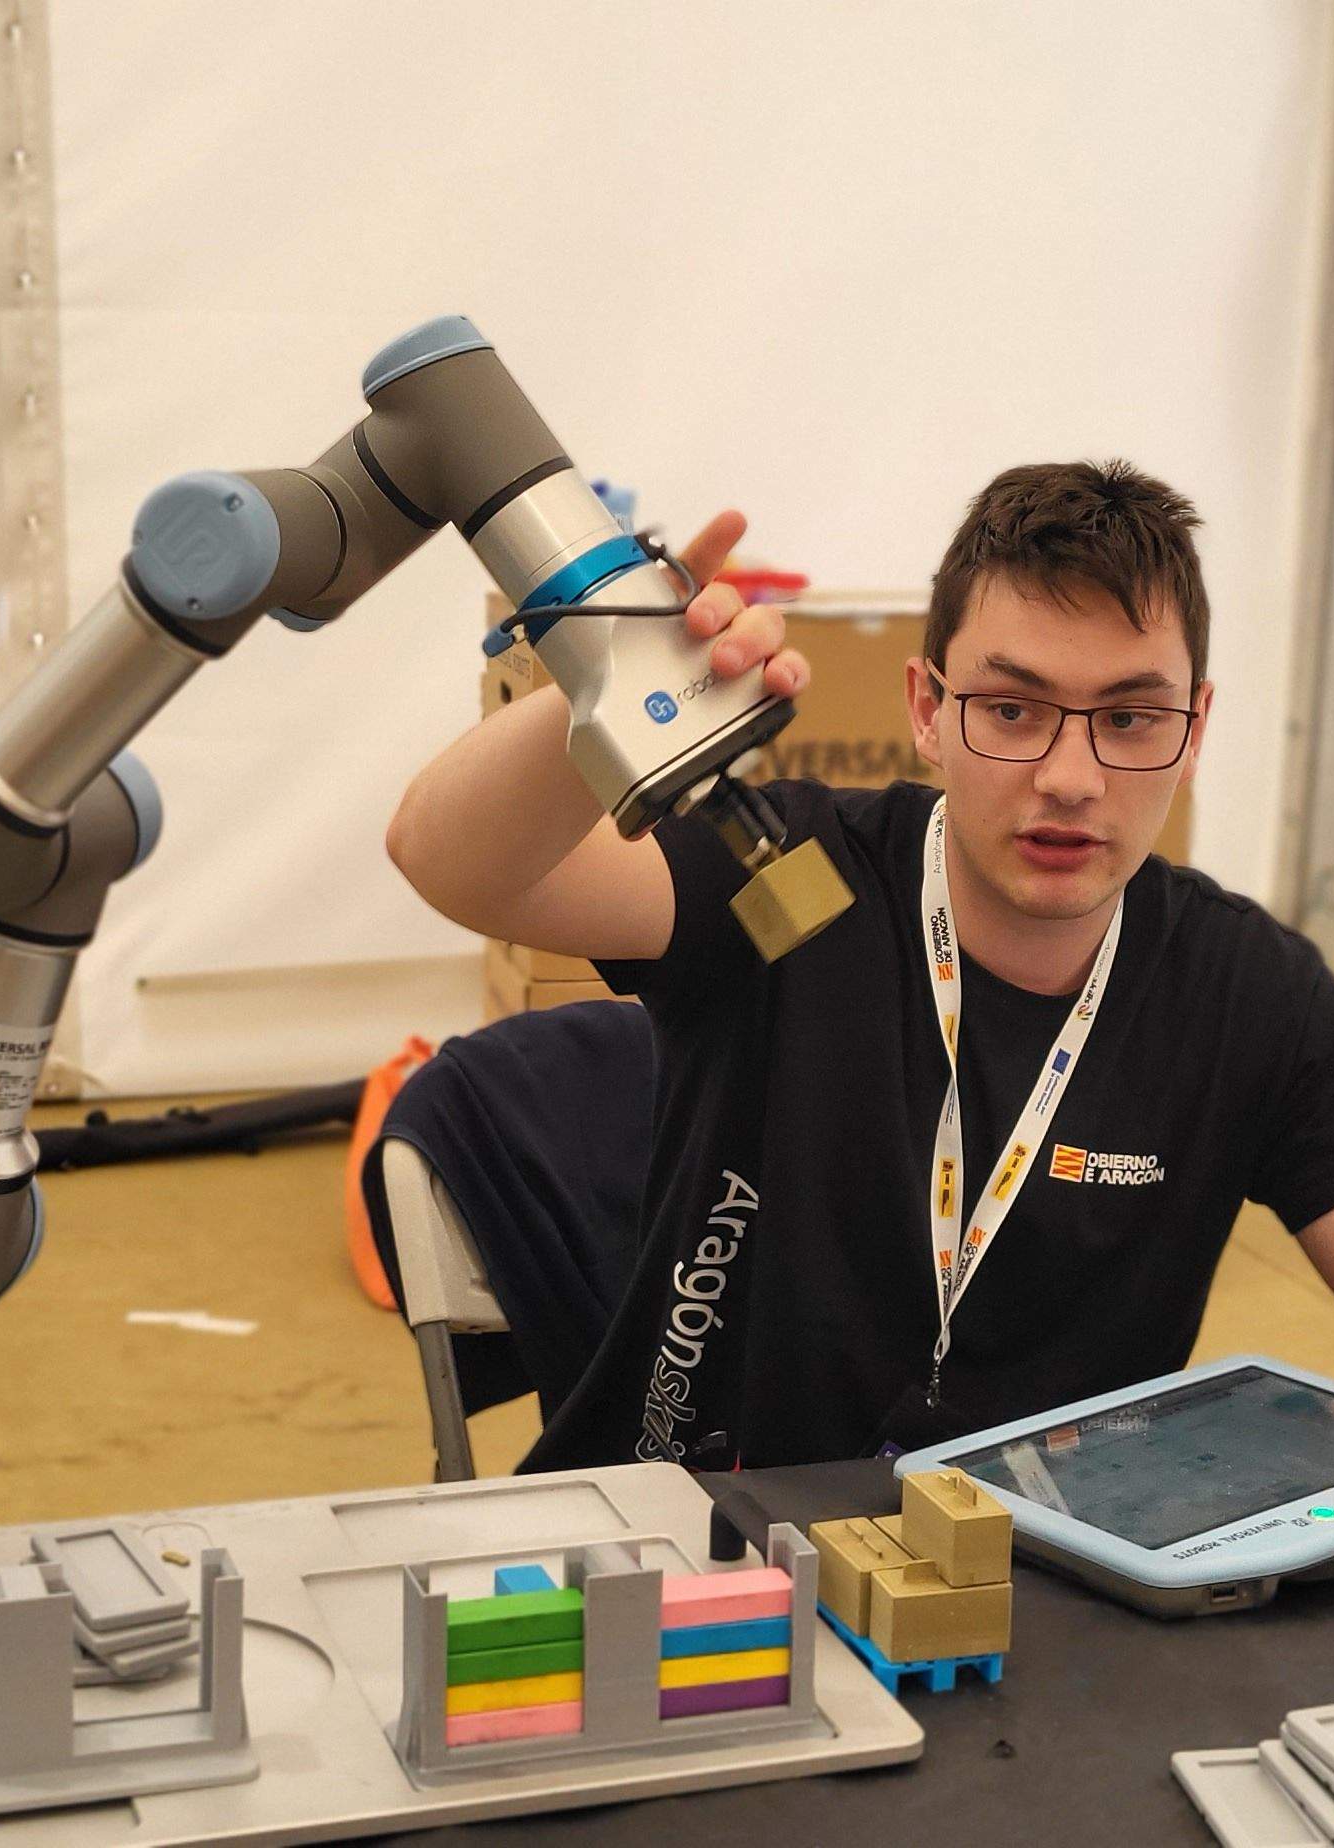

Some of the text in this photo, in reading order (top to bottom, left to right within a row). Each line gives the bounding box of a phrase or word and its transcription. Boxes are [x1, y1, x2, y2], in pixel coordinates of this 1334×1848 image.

[676, 672, 717, 702] robo
[768, 739, 932, 779] VERSAL
[931, 915, 944, 964] GOBIERNO
[943, 948, 953, 964] DE
[1083, 1167, 1166, 1186] E ARAGON
[1087, 1152, 1159, 1171] OBIERNO
[635, 1168, 760, 1463] Aragónsks
[1171, 1518, 1287, 1561] UNIVERSAL ROBOTS
